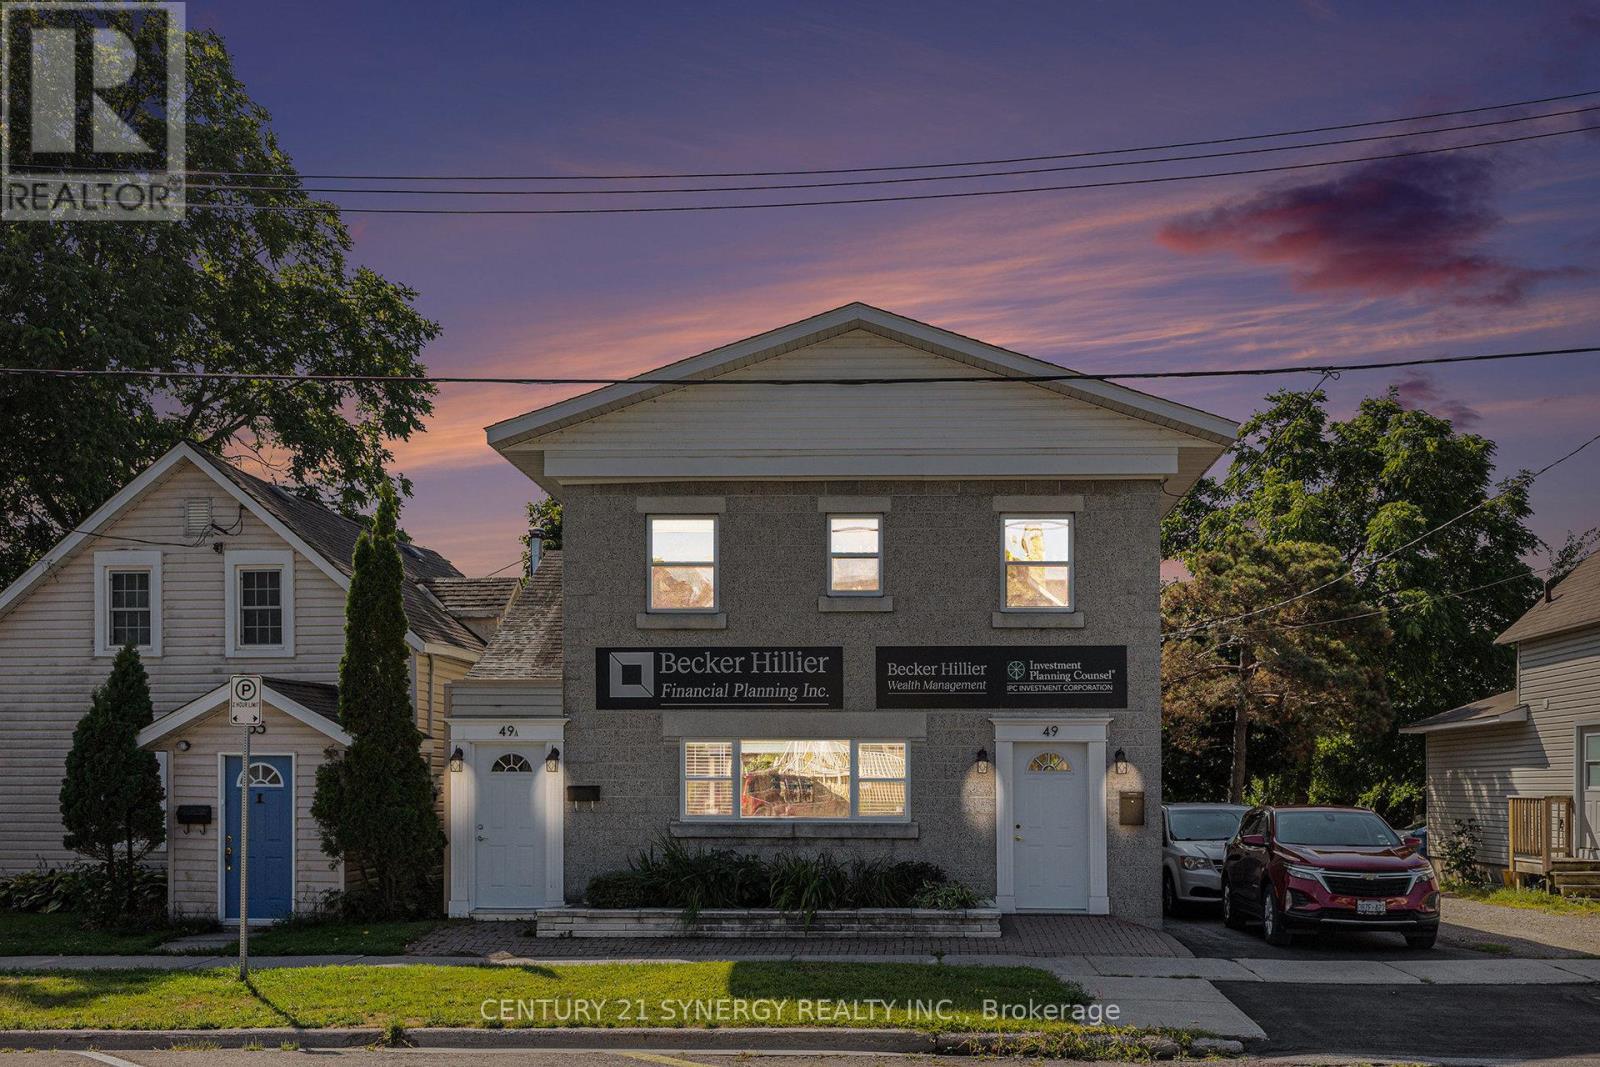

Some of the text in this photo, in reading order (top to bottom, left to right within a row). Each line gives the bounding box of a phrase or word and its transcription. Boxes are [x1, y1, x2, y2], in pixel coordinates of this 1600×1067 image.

[659, 651, 830, 674] Becker Hillier
[1029, 660, 1082, 670] Investment
[887, 662, 988, 676] Becker Hillier
[1029, 670, 1071, 682] Planning
[242, 684, 252, 696] P
[661, 682, 830, 701] Financial Planning Inc.
[887, 680, 987, 692] Wealth Management
[1019, 684, 1062, 692] INVESTMENT
[1042, 725, 1059, 737] 49
